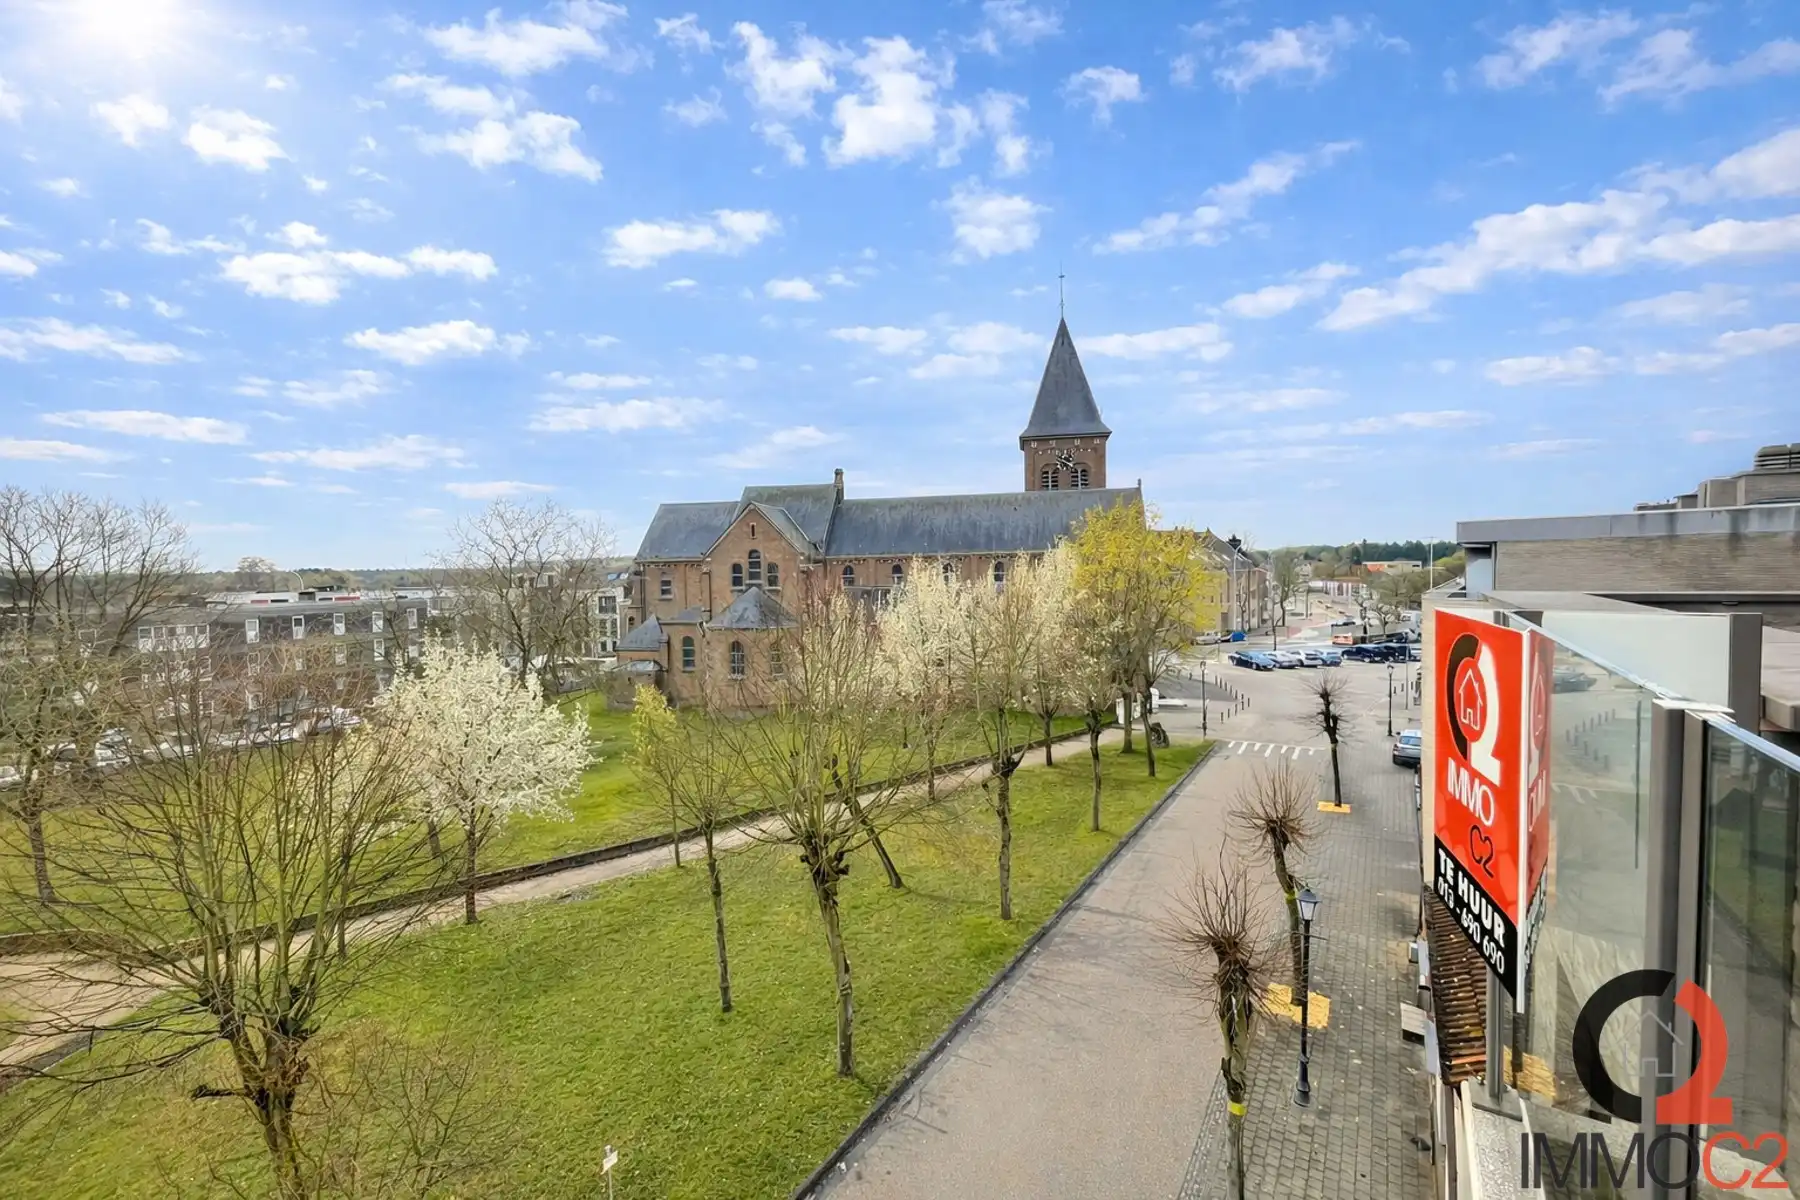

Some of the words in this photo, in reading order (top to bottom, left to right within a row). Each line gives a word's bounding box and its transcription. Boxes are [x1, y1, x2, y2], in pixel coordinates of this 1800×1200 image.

[1447, 757, 1495, 826] IMMO
[1470, 825, 1494, 878] C2
[1438, 848, 1454, 886] TE
[1458, 870, 1505, 948] HUUR
[1461, 908, 1480, 944] 690
[1483, 935, 1505, 974] 690
